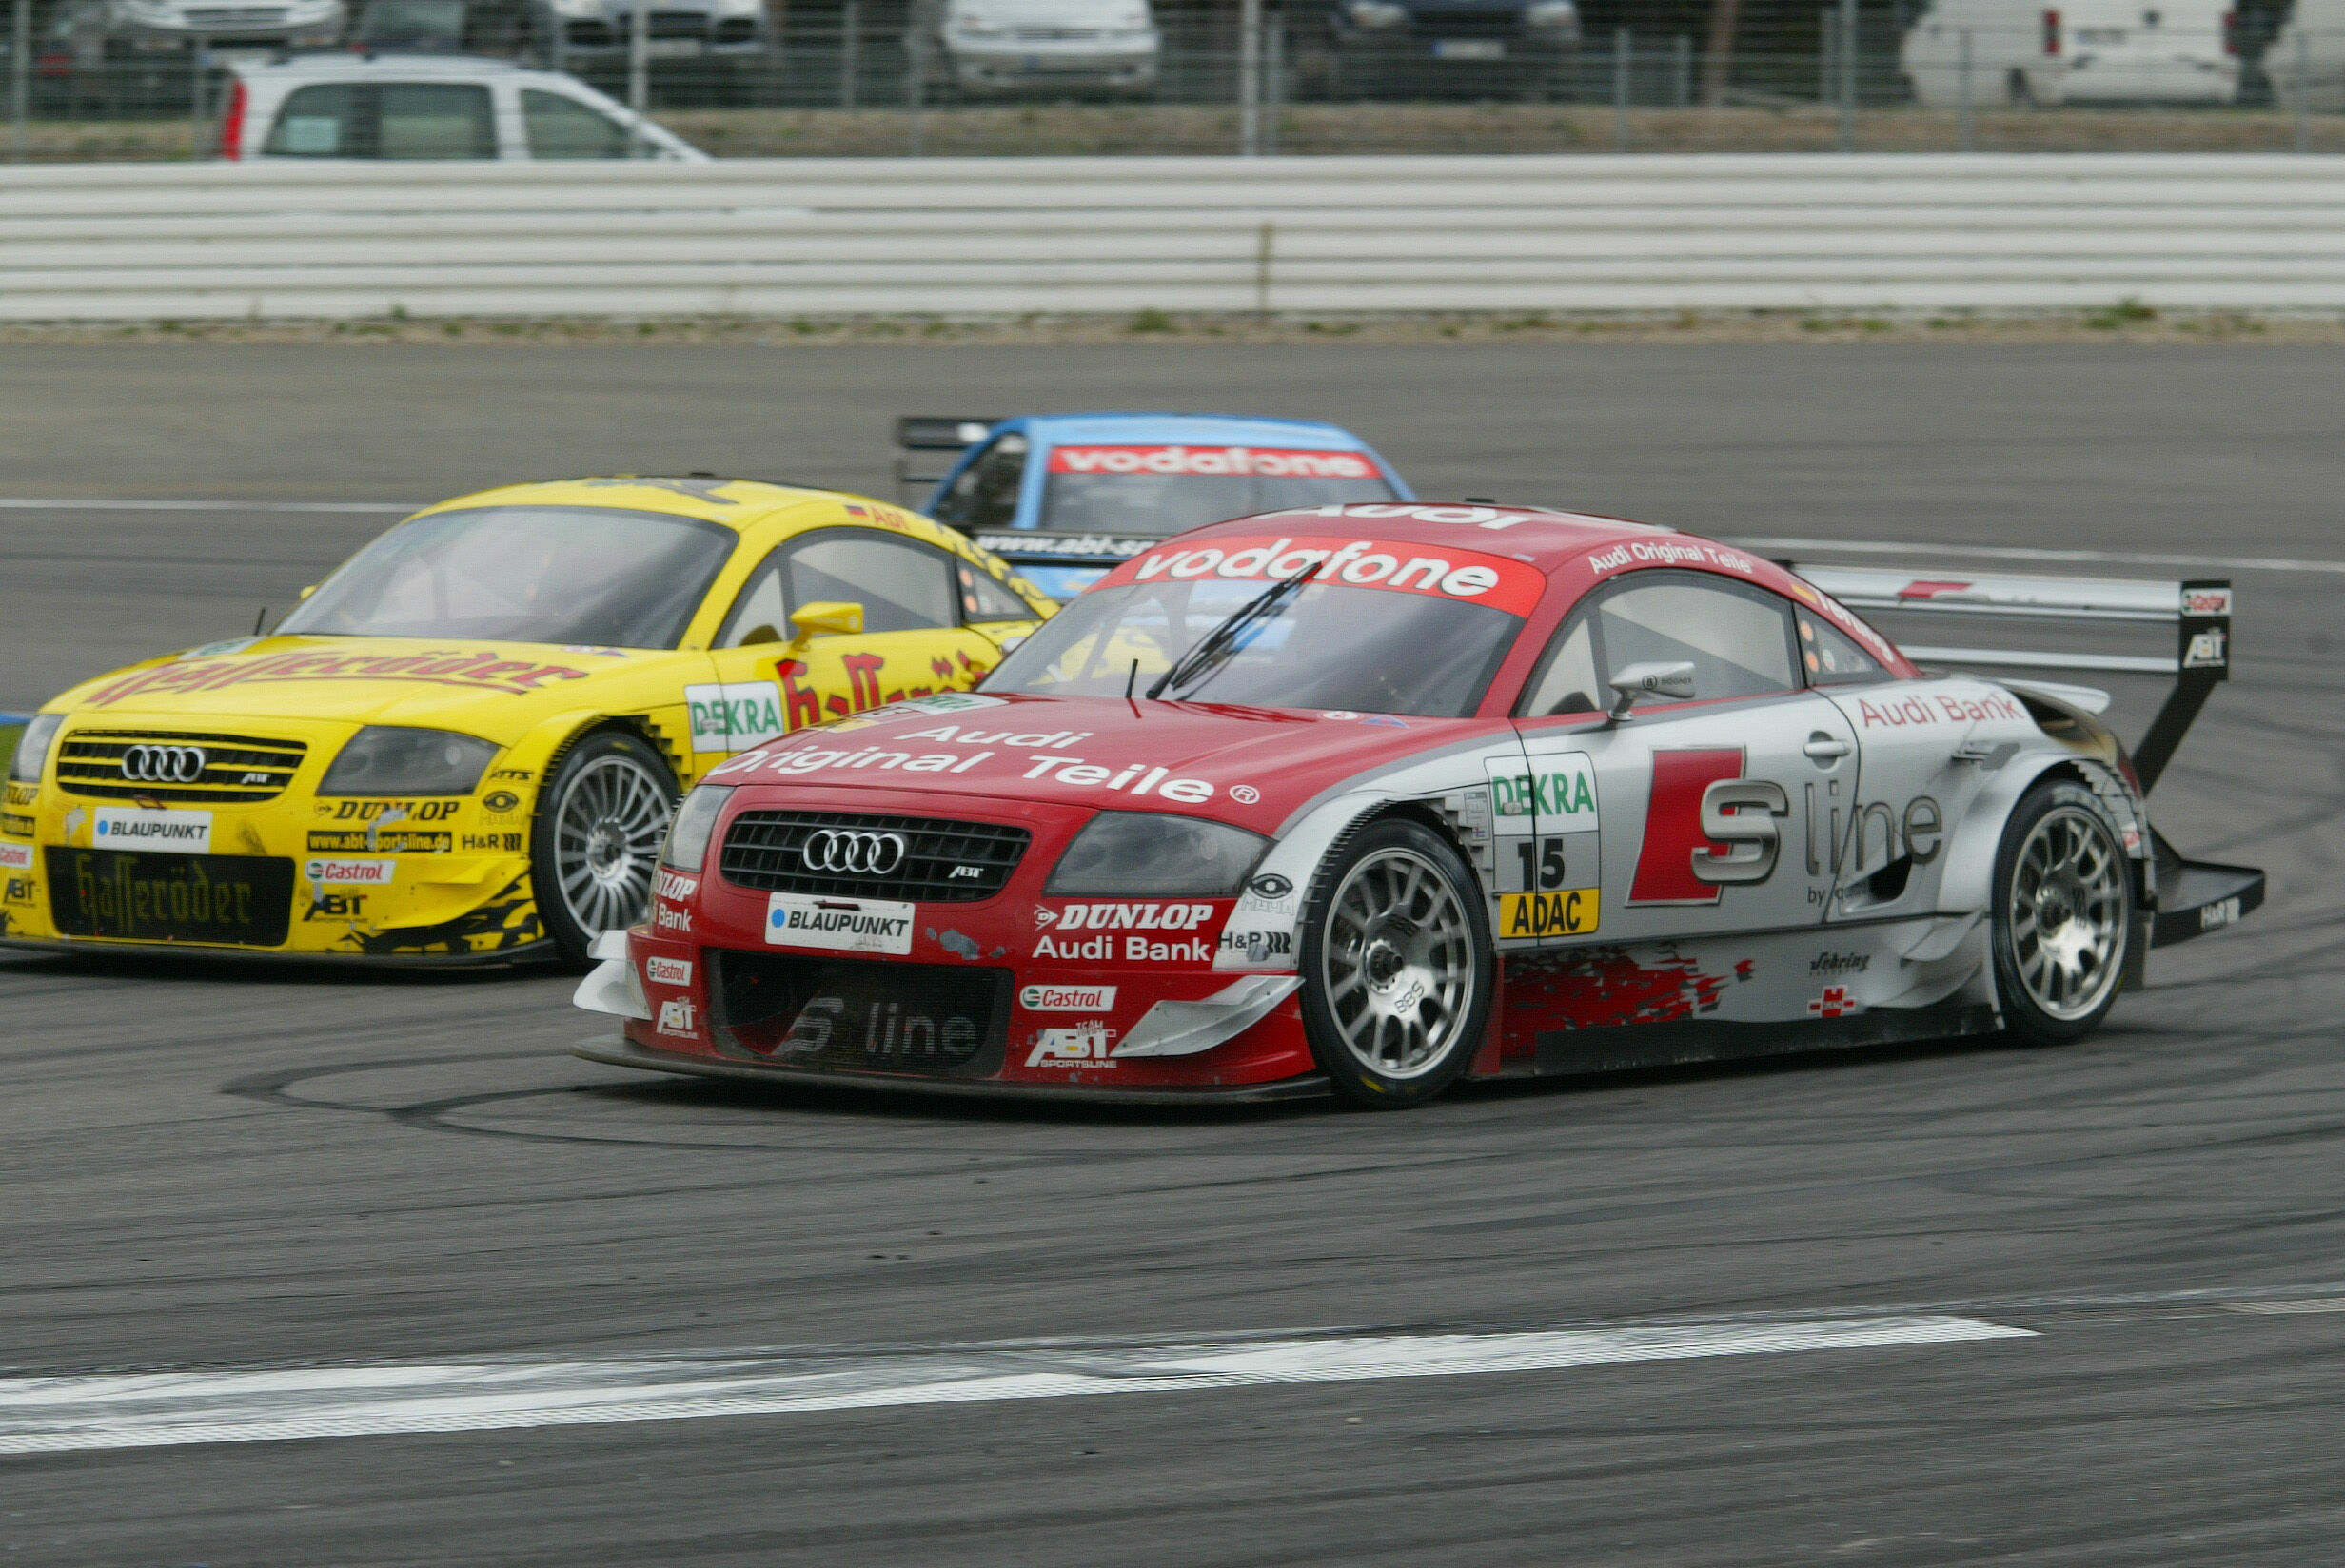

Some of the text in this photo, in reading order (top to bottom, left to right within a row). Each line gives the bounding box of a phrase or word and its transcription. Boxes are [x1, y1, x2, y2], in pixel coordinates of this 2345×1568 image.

[1059, 444, 1369, 477] vodafone
[1134, 539, 1500, 598] vodafone
[1588, 545, 1633, 575] Audi
[1631, 542, 1705, 564] Original
[691, 697, 785, 736] DEKRA
[1858, 692, 2023, 728] Audi Bank
[893, 724, 1094, 749] Audi
[707, 745, 995, 775] Original
[1021, 755, 1216, 804] Teile
[1491, 771, 1596, 816] DEKRA
[109, 820, 208, 842] BLAUPUNKT
[462, 833, 499, 852] H&R
[1690, 778, 1943, 886] S line
[325, 863, 383, 881] Castrol
[949, 866, 985, 879] ABT
[1517, 838, 1566, 892] 15
[303, 892, 368, 922] ABT
[1808, 886, 1826, 904] by
[658, 902, 693, 932] Bank
[788, 911, 910, 938] BLAUPUNKT
[1056, 904, 1214, 930] DUNLOP
[1511, 892, 1582, 935] ADAC
[1032, 935, 1211, 961] Audi Bank
[656, 961, 685, 982] Castrol
[1042, 989, 1103, 1007] Castrol
[1393, 980, 1426, 1014] BBS
[656, 1001, 697, 1034] ABT
[867, 1002, 978, 1055] line
[1024, 1028, 1117, 1068] ABT
